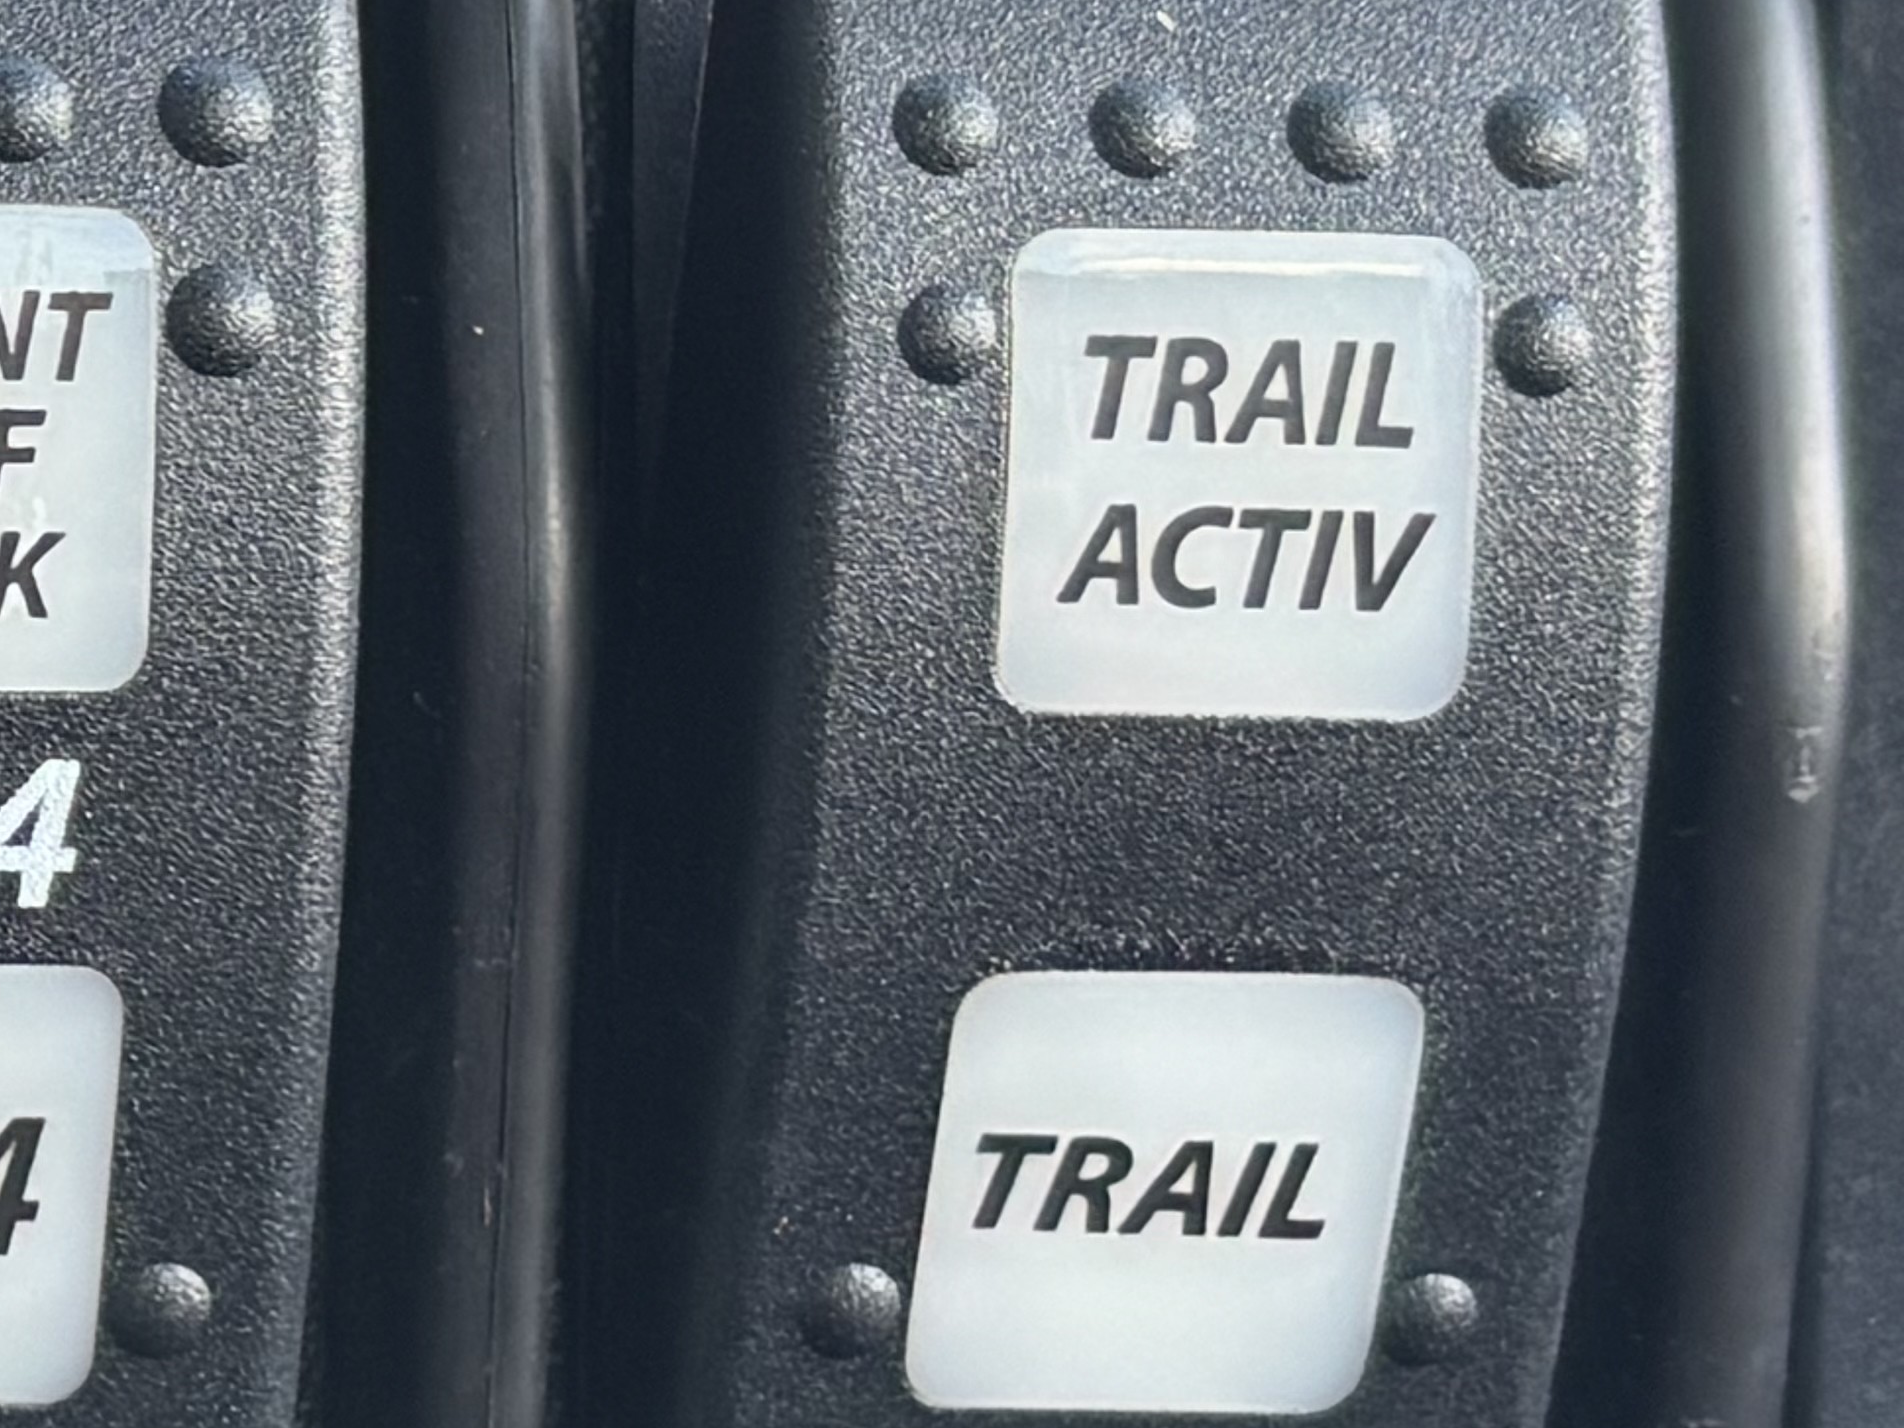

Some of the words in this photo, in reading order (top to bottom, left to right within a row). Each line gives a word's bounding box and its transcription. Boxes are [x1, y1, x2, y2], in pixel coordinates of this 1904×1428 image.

[1085, 335, 1414, 449] TRAIL
[1057, 504, 1435, 612] ACTIV
[973, 1132, 1327, 1240] TRAIL
